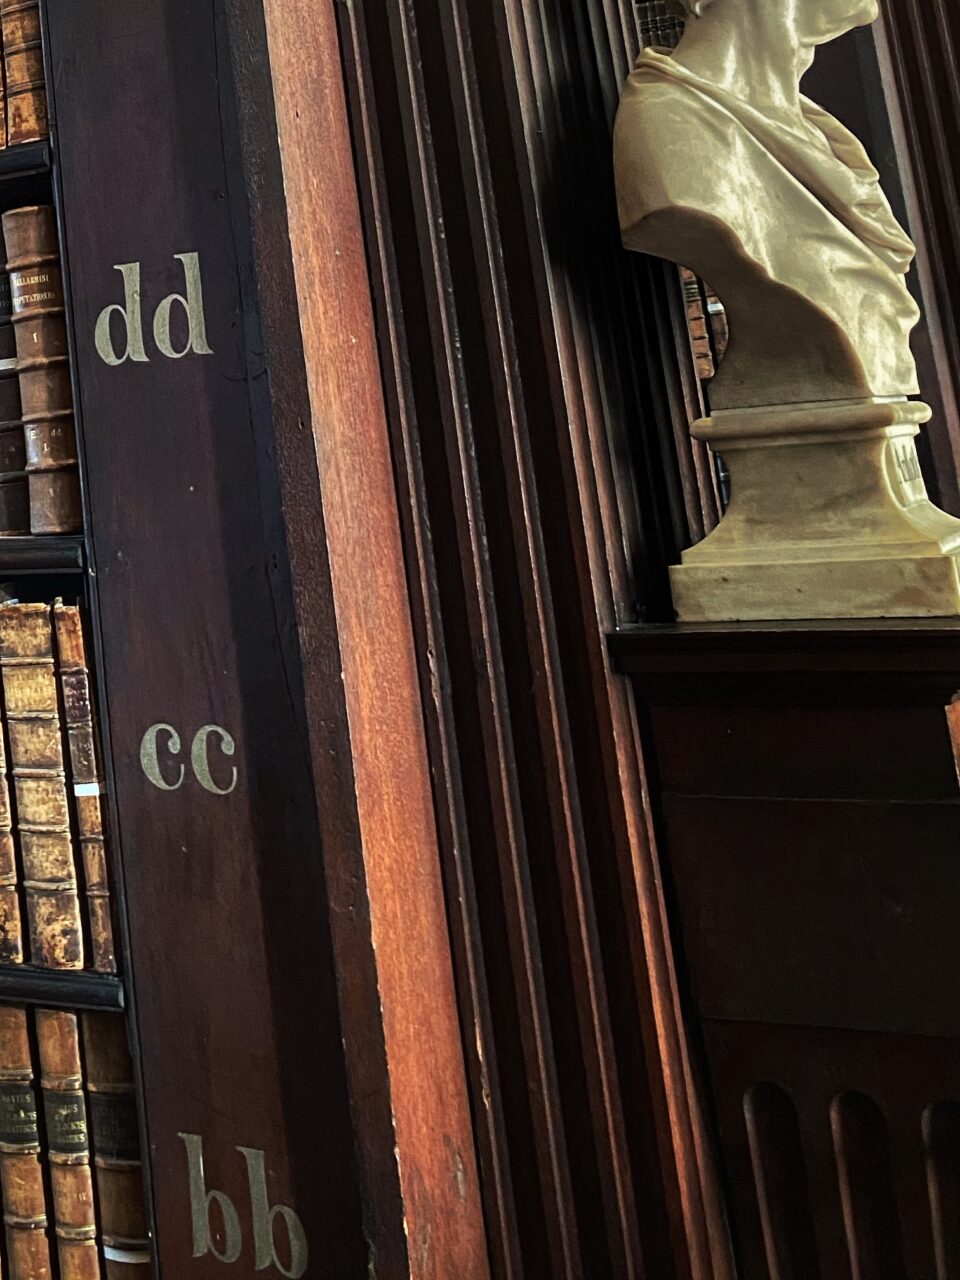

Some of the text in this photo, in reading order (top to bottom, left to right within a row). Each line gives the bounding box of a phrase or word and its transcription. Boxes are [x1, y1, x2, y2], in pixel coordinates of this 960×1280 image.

[94, 251, 214, 367] dd
[140, 723, 237, 795] cc
[177, 1132, 308, 1279] bb
